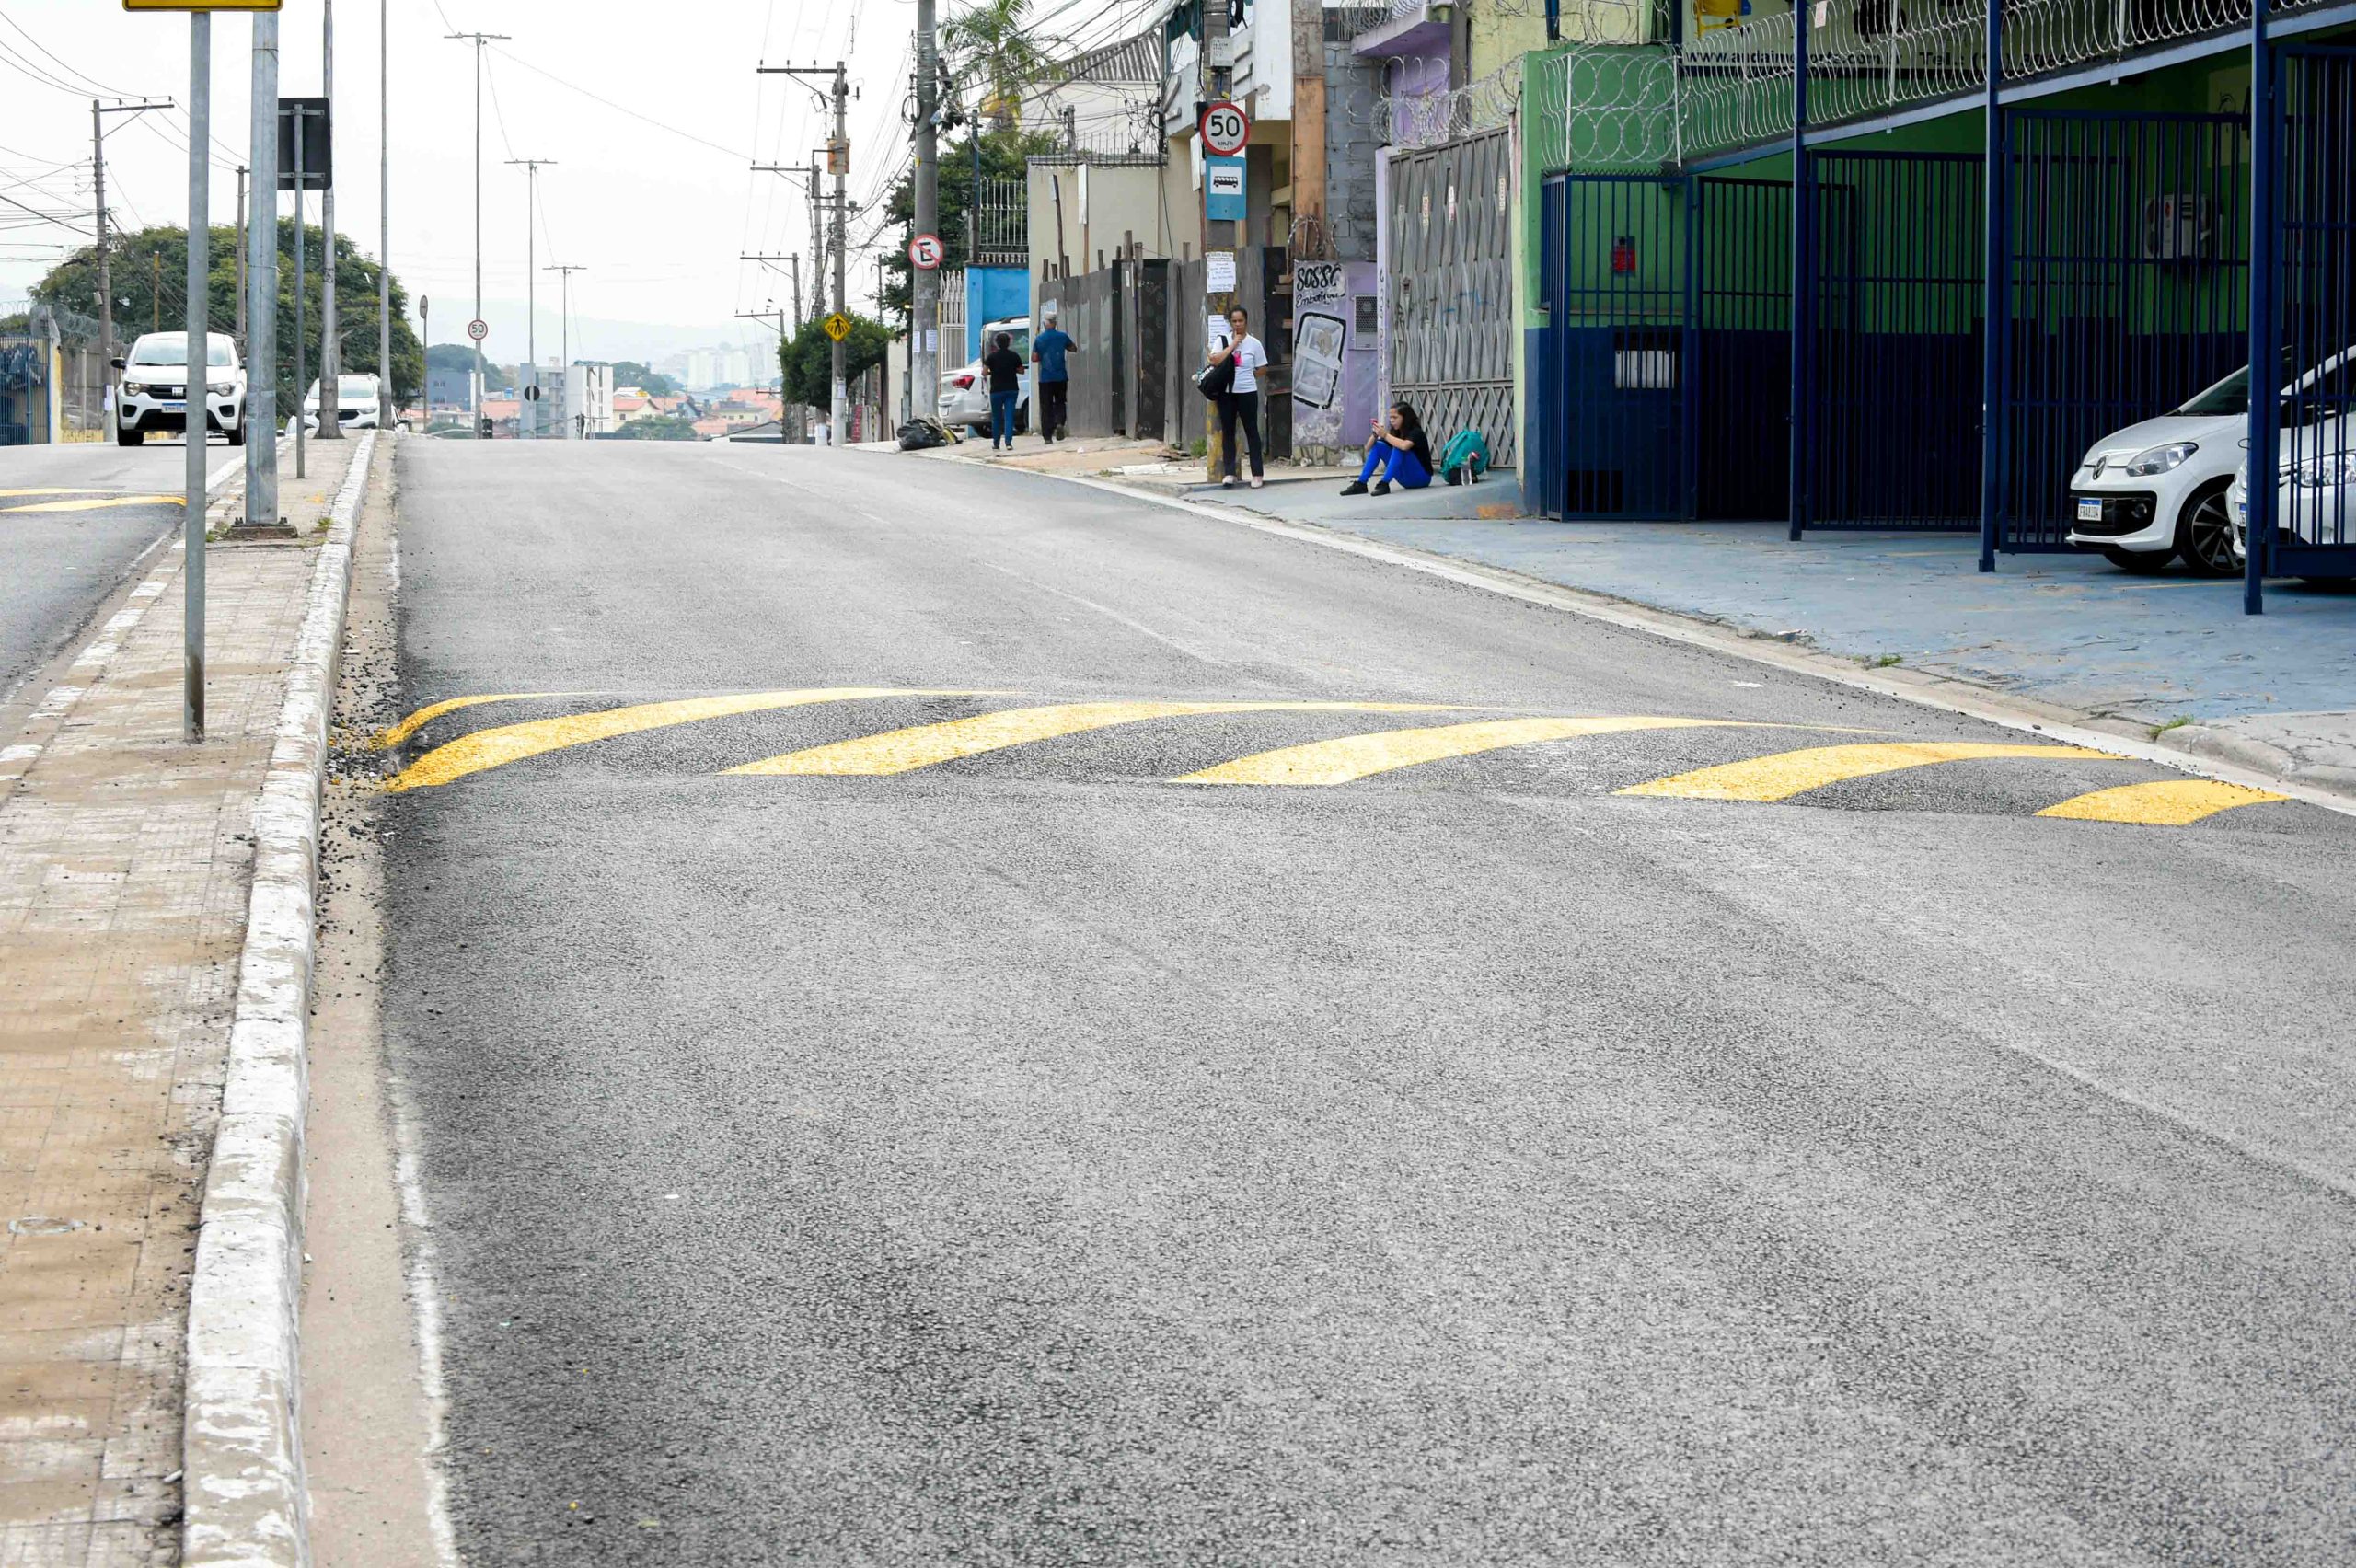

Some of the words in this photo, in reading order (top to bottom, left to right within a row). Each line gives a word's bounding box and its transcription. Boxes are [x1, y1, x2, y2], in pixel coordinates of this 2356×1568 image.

[1210, 115, 1241, 137] 50
[919, 241, 934, 262] E
[471, 324, 484, 333] 50
